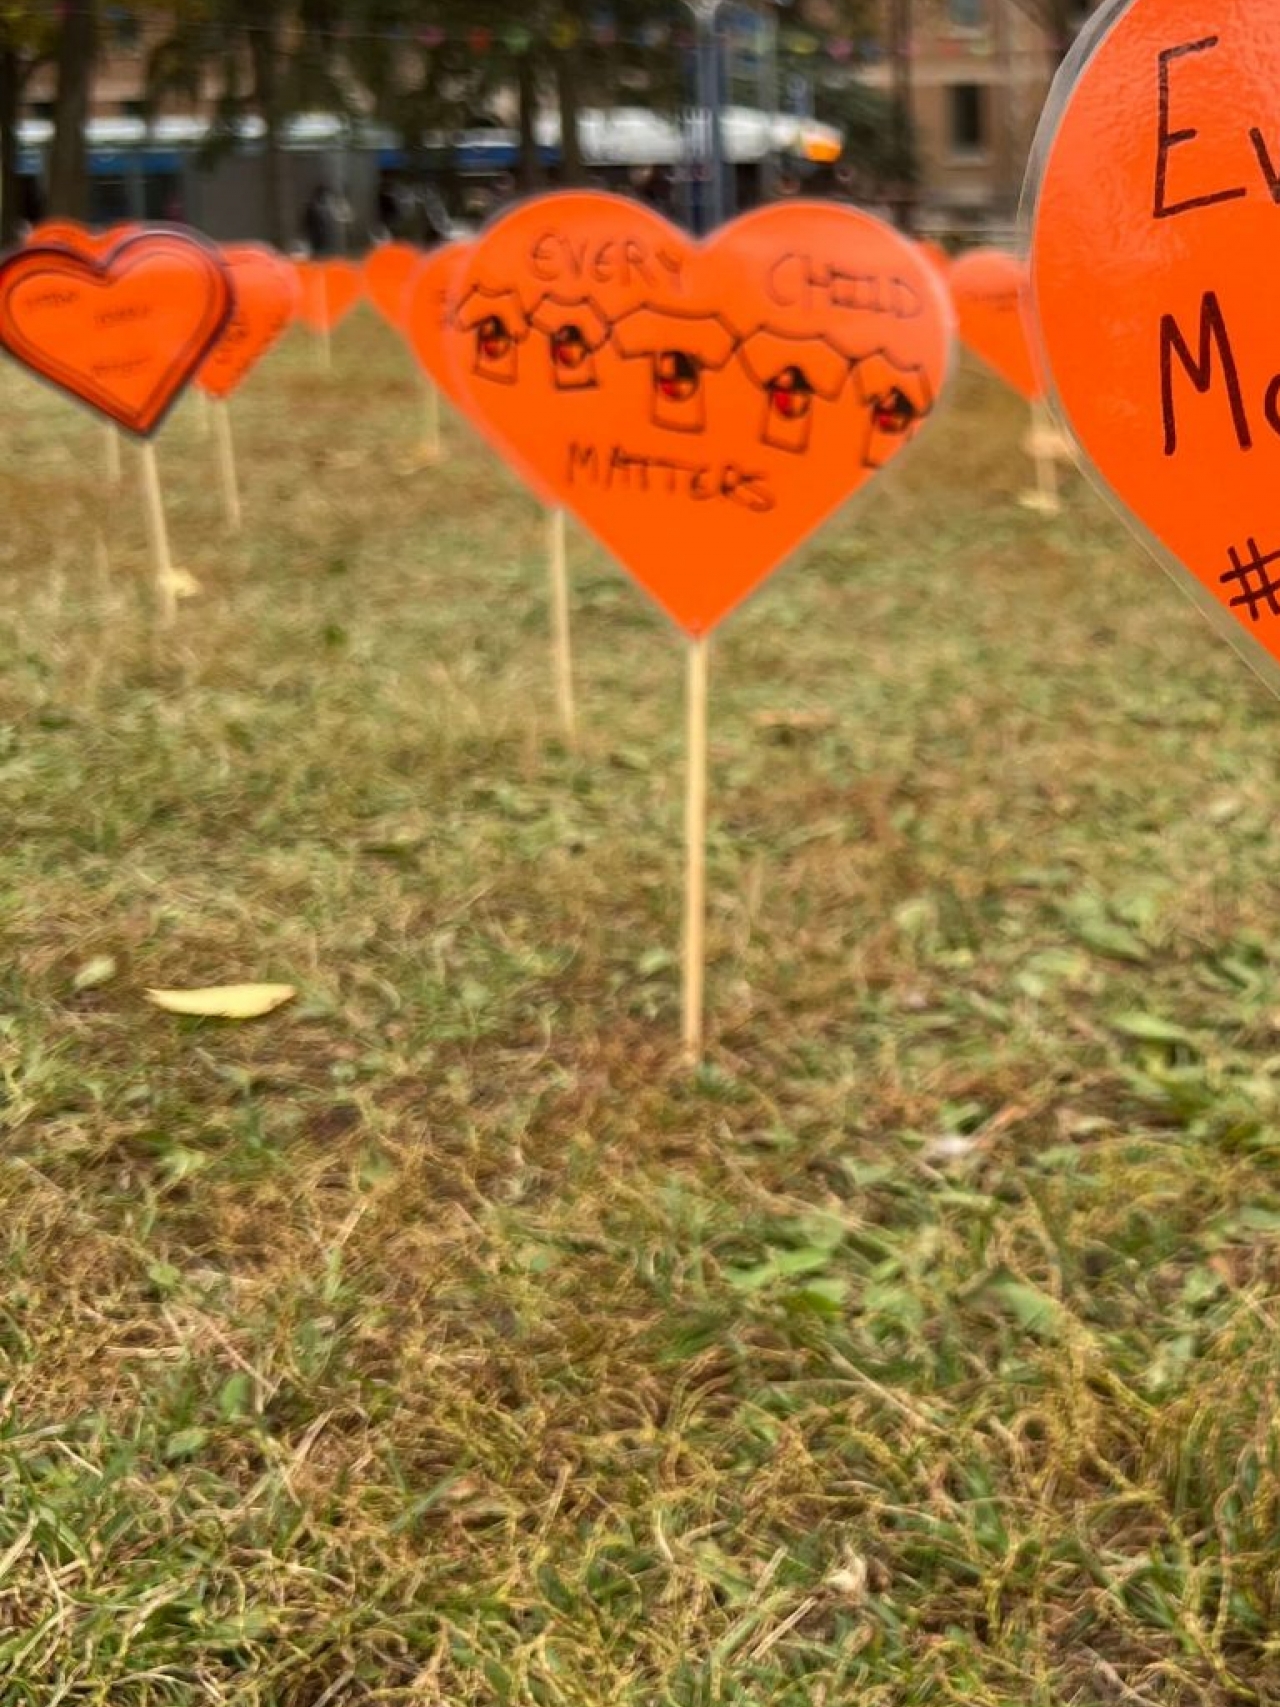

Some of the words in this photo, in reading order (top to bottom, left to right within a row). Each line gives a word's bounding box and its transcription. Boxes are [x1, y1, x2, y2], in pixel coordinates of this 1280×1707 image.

[531, 231, 685, 292] EVERY
[767, 252, 925, 319] CHILD
[566, 440, 775, 512] MATTERS
